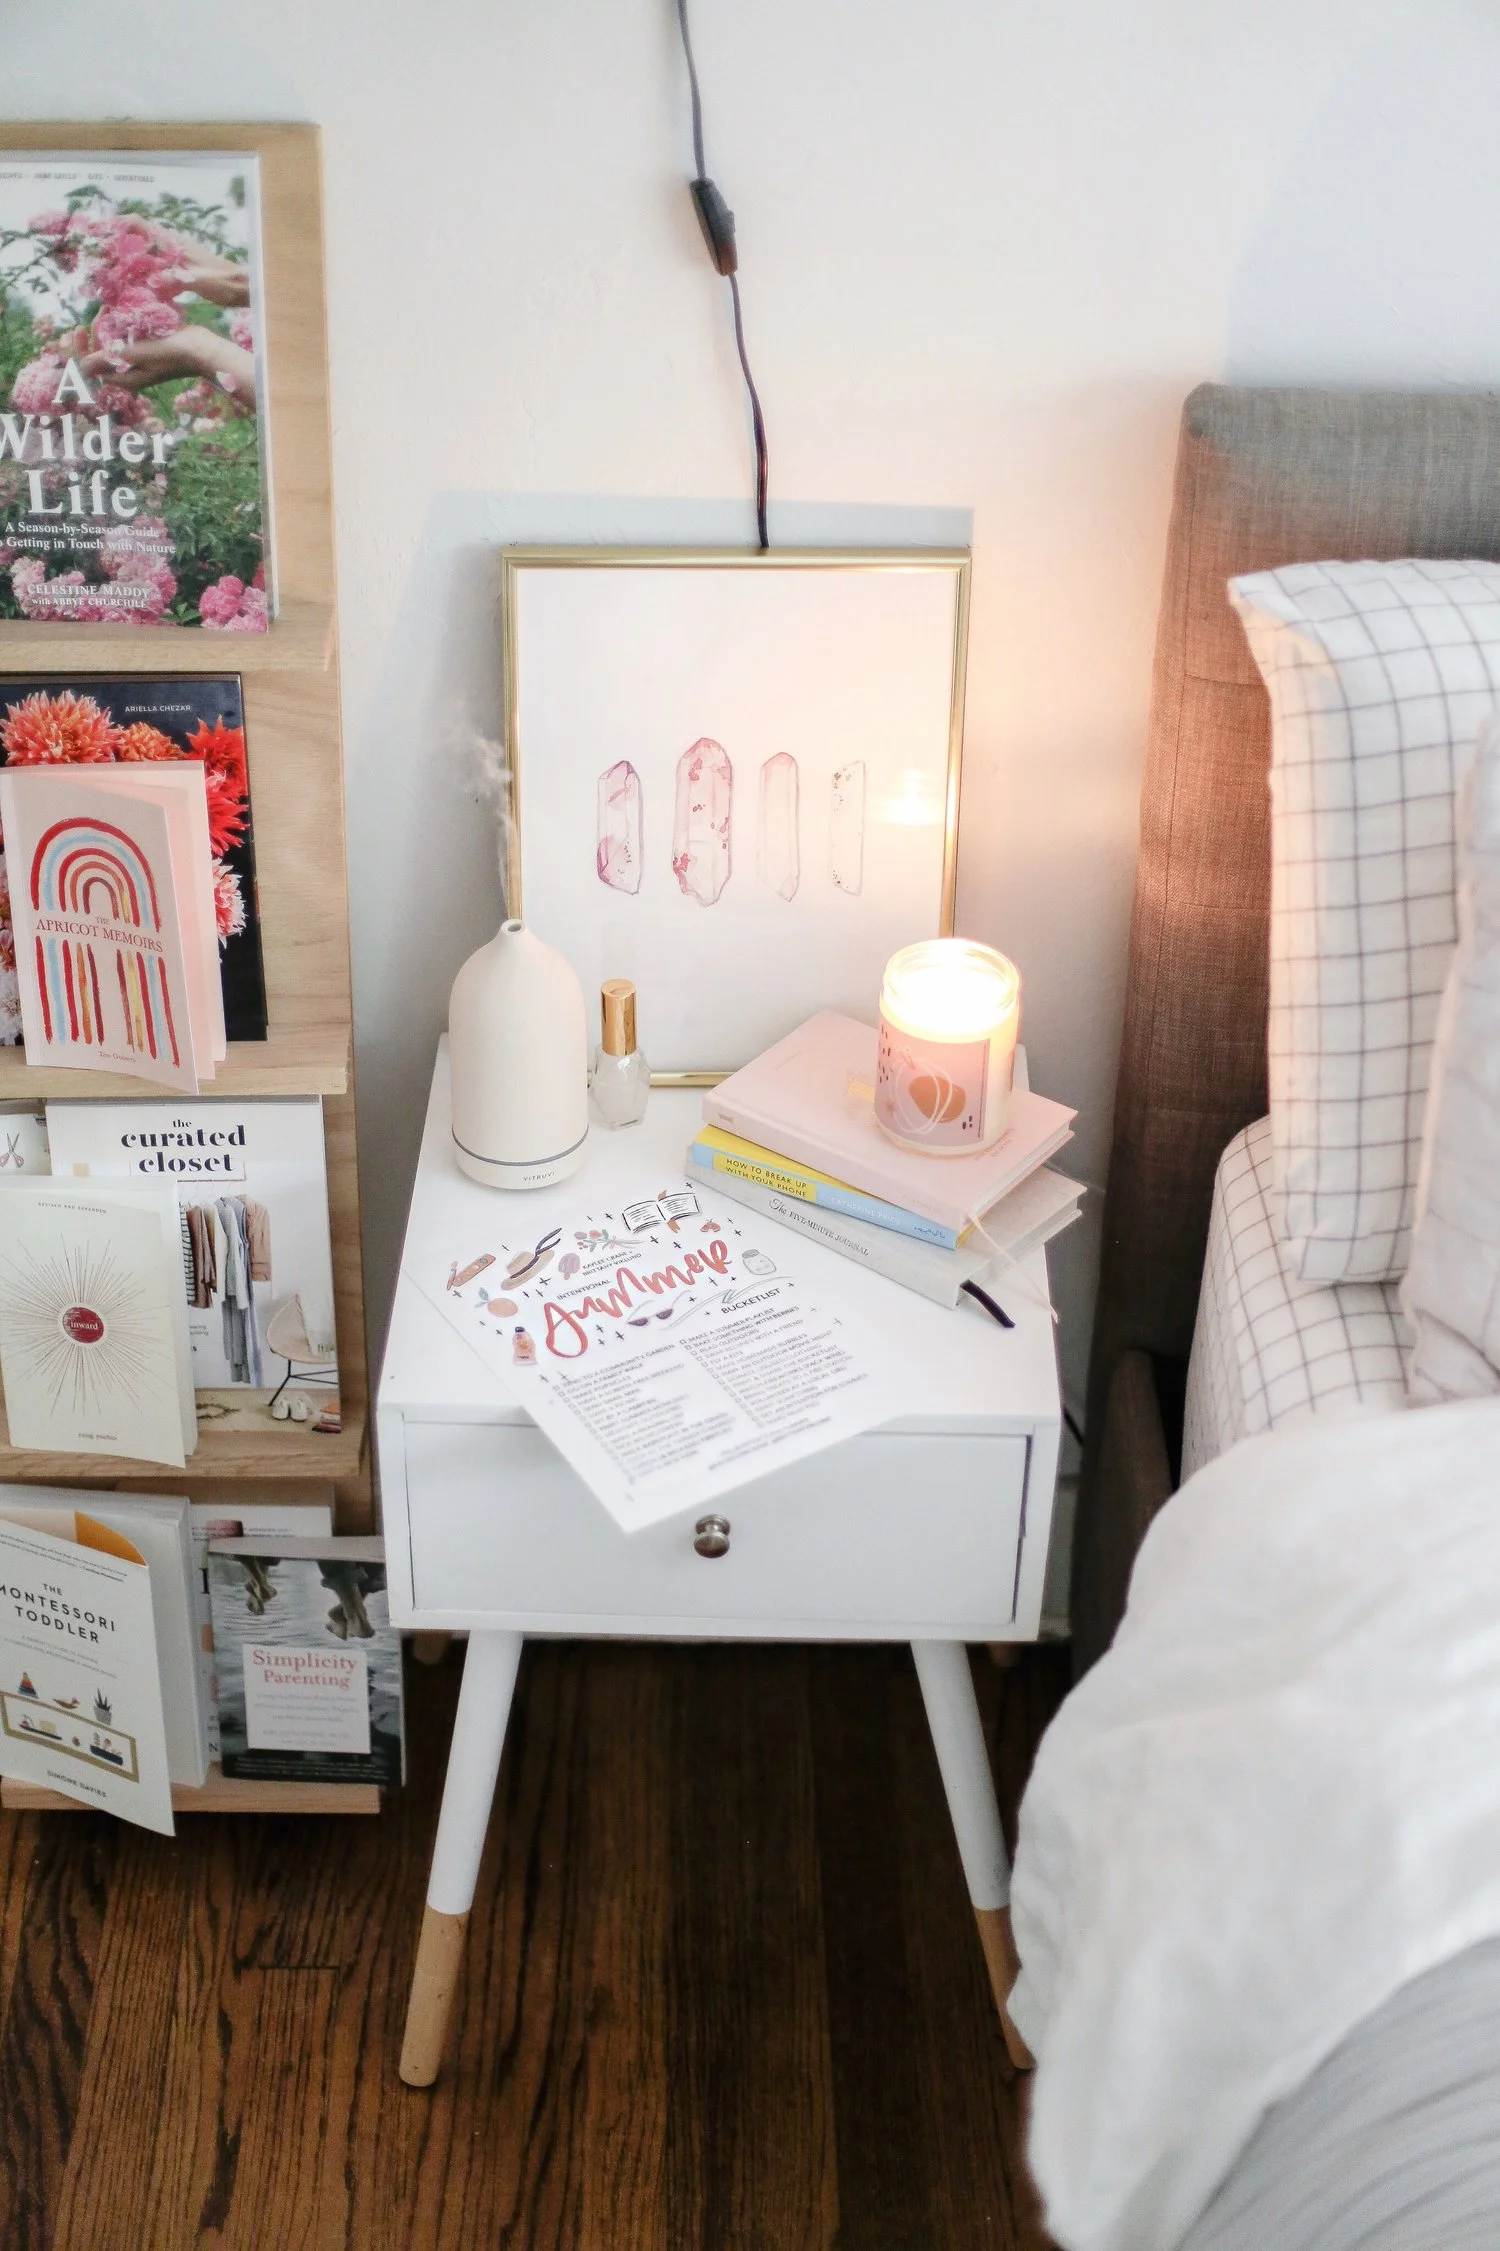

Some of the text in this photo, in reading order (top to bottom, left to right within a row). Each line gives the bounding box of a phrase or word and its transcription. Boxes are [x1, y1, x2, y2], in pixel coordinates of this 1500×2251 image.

[53, 357, 96, 405] A
[0, 413, 173, 464] Wilder
[26, 470, 139, 518] Life
[6, 523, 160, 537] A Season-by-Season Guide
[7, 537, 51, 550] Getting
[54, 539, 65, 548] in
[68, 539, 104, 549] Touch
[107, 541, 132, 551] with
[136, 543, 177, 554] Nature
[27, 584, 150, 599] CELESTINE MADDY
[125, 704, 191, 713] ARIELLA CHEZAR
[36, 919, 163, 953] APRICOT MEMOIRS
[172, 1119, 192, 1129] the
[121, 1125, 247, 1148] curated
[138, 1151, 235, 1173] closet
[523, 1171, 556, 1182] VITRUVI
[726, 1158, 807, 1189] HOW TO BREAK UP
[726, 1166, 807, 1199] WITH YOUR PHONE
[769, 1198, 869, 1256] The FIVE-MINUTE JOURNAL
[582, 1258, 604, 1270] KAYLEE
[604, 1252, 627, 1265] CRANE
[582, 1263, 613, 1277] BRITTANY
[556, 1279, 612, 1301] INTENTIONAL
[720, 1288, 782, 1315] BUCKETLIST
[71, 1319, 98, 1331] inward
[688, 1332, 707, 1342] MAKE
[716, 1320, 745, 1333] SUMMER
[745, 1309, 775, 1321] PLAYLIST
[754, 1317, 773, 1325] WITH
[773, 1306, 799, 1318] BERRIES
[43, 1583, 63, 1597] THE
[0, 1585, 115, 1632] MONTESSORI
[14, 1605, 99, 1644] TODDLER
[252, 1648, 357, 1673] Simplicity
[263, 1670, 351, 1689] Parenting
